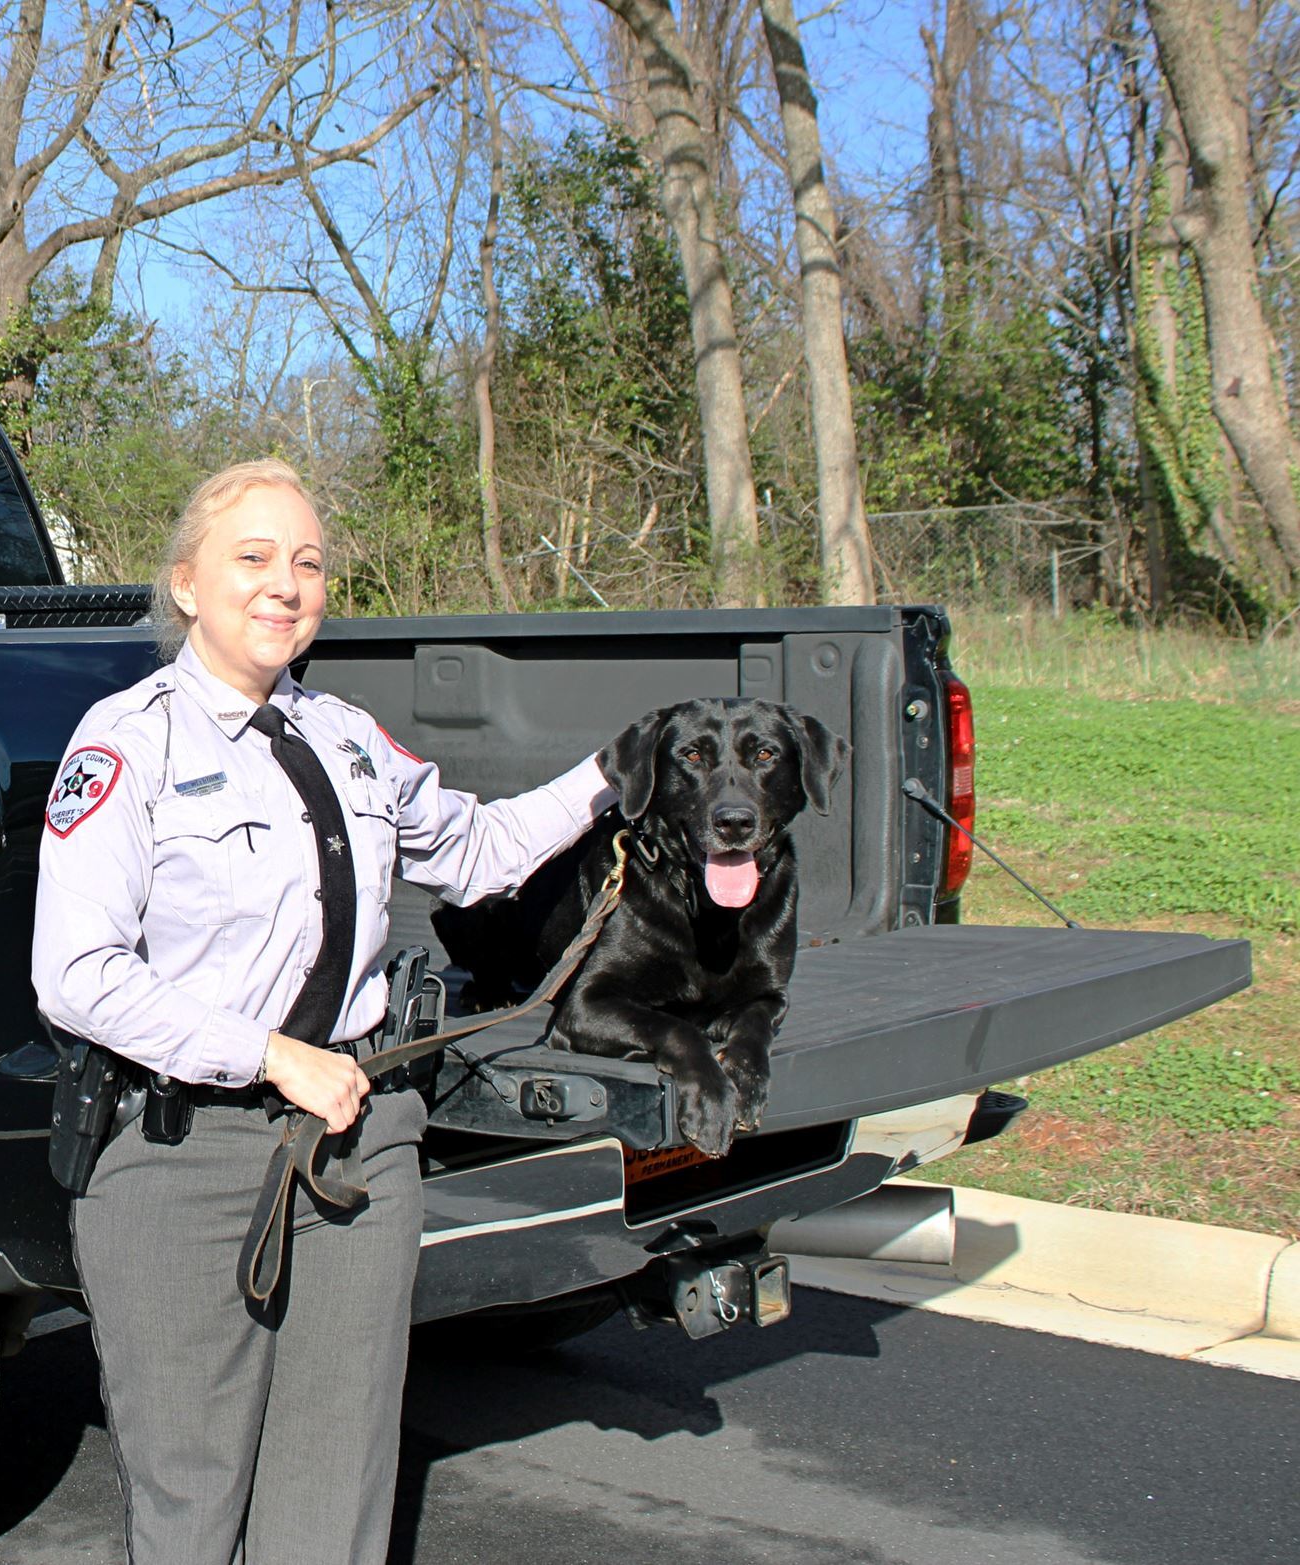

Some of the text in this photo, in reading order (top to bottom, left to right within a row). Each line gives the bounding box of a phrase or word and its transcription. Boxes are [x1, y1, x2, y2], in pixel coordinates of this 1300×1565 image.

[85, 753, 114, 768] COUNTY
[54, 816, 75, 826] OFFICE
[642, 1151, 695, 1175] PERMANENT
